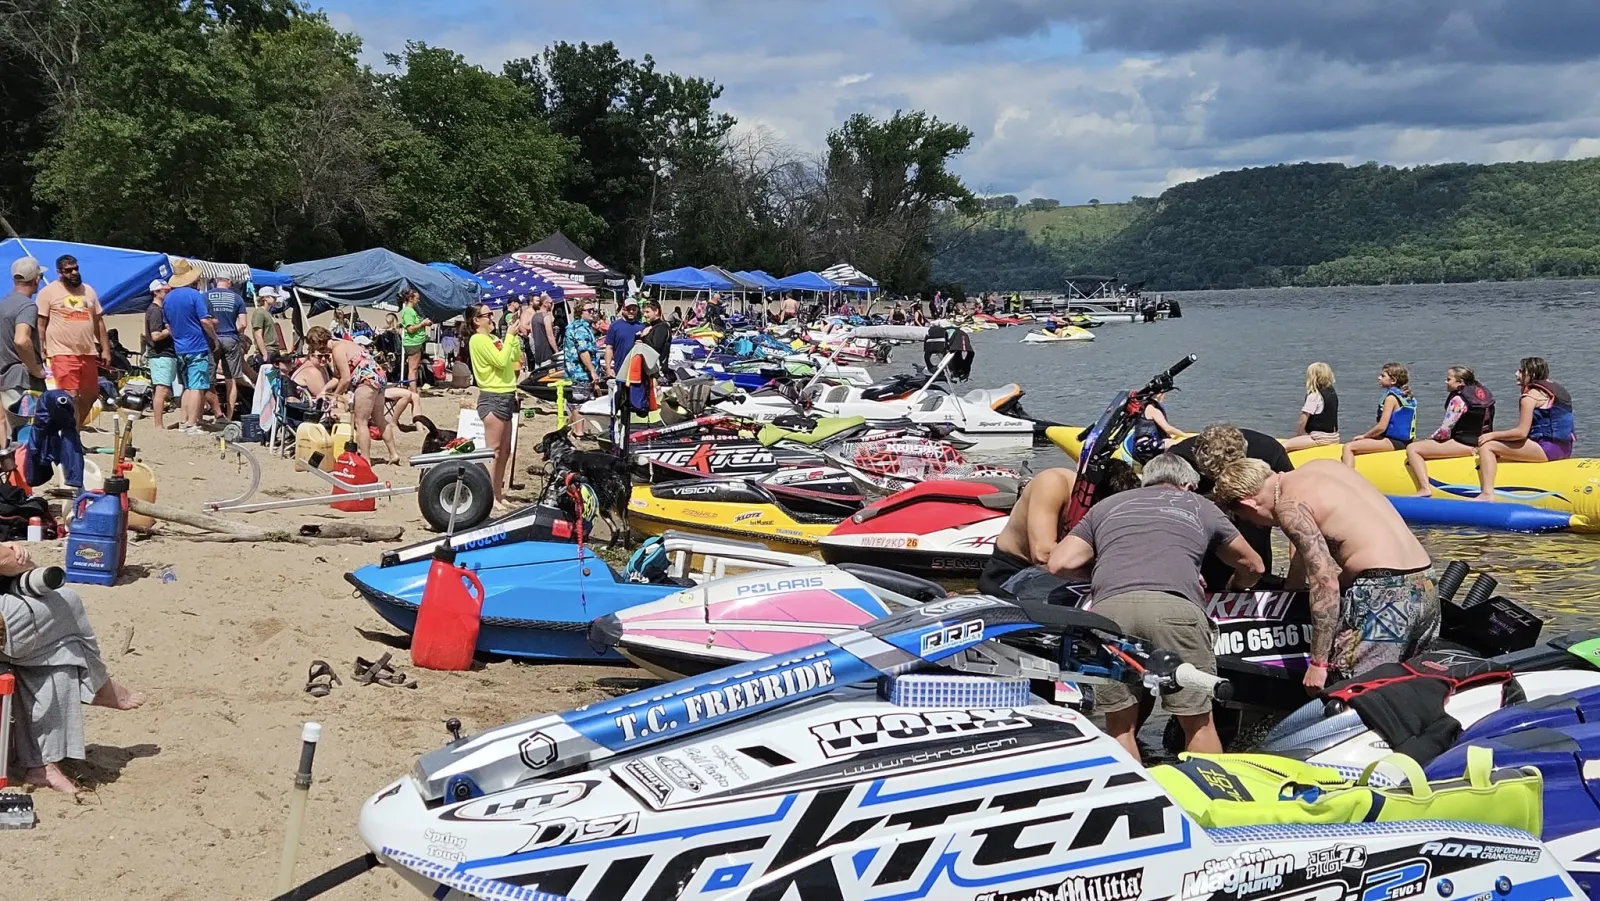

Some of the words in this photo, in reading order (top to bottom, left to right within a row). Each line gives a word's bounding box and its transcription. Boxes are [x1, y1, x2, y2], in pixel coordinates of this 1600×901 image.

[673, 486, 717, 495] VISION
[735, 511, 763, 522] KLOTZ
[906, 539, 918, 547] 26
[737, 577, 823, 595] POLARIS
[921, 619, 984, 652] RRP
[1213, 631, 1244, 656] MC
[1247, 624, 1299, 651] 6556
[615, 704, 678, 742] T.C.
[682, 657, 836, 724] FREERIDE
[810, 708, 1032, 758] WORX
[843, 737, 1018, 776] www.rickroy.com
[484, 789, 570, 817] HT
[424, 828, 467, 848] Spring
[427, 845, 467, 863] Touch
[1308, 850, 1337, 864] JET
[1419, 841, 1483, 859] ADR
[1480, 853, 1539, 863] CRANKSHAFTS
[1482, 846, 1541, 857] PERFORMANCE
[1182, 854, 1295, 899] Magnum
[1306, 861, 1343, 880] PILOT
[1055, 873, 1140, 901] Militia
[1237, 875, 1283, 899] pump
[1391, 883, 1422, 899] EVO-1
